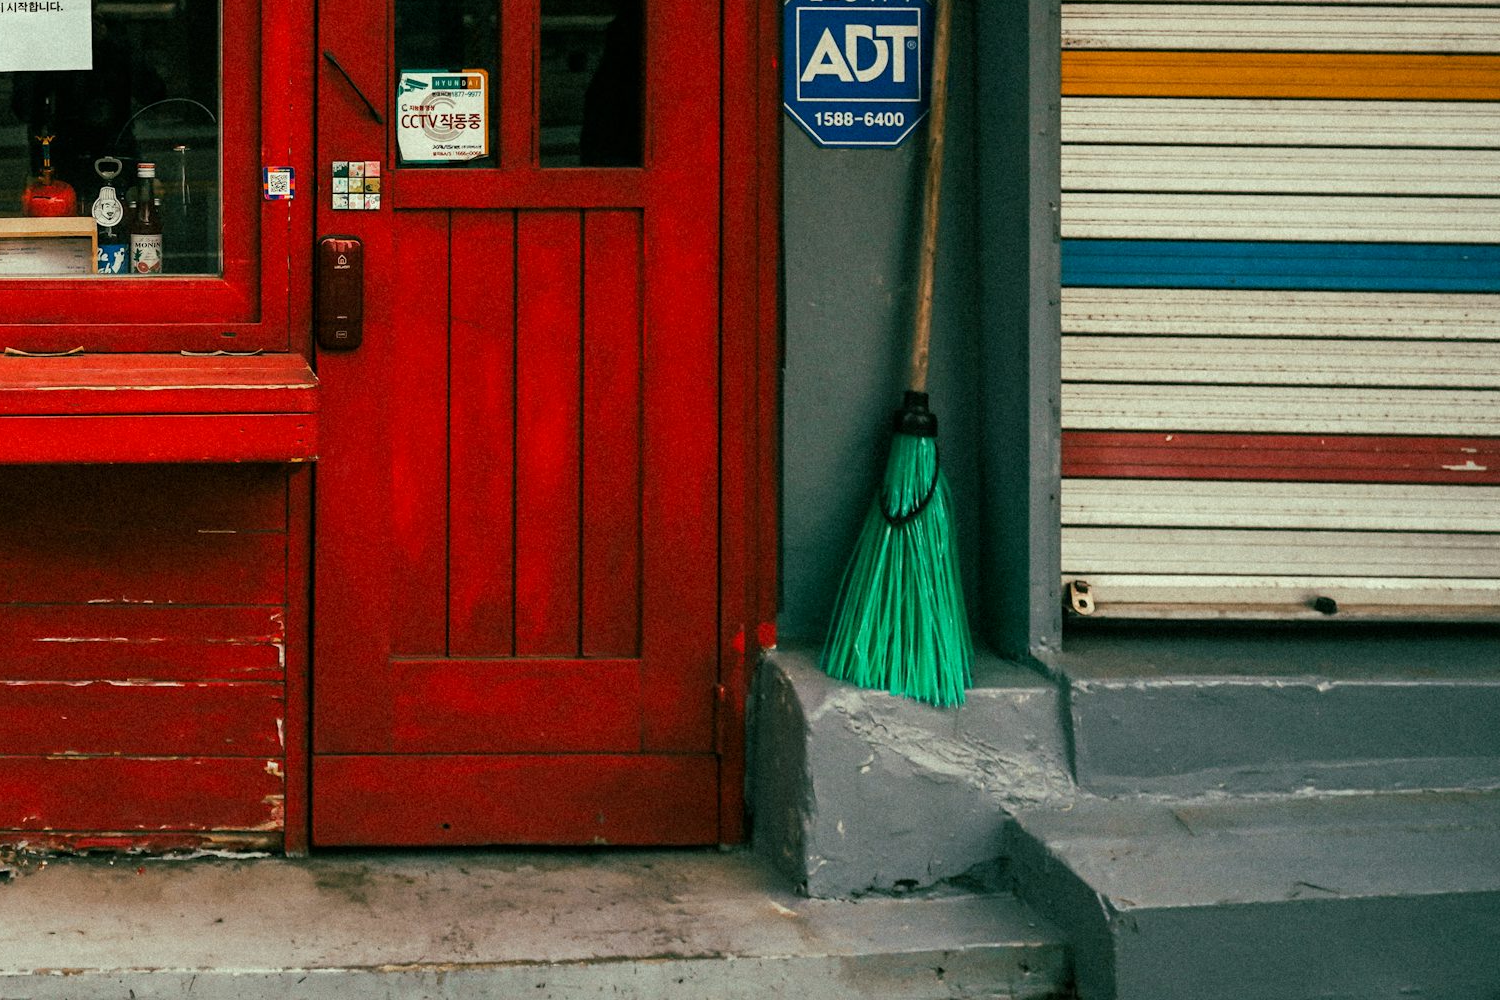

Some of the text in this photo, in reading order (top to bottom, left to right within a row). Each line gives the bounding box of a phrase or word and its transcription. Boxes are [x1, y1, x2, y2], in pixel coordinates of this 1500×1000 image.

[7, 1, 64, 13] 시작합니다.
[800, 24, 918, 83] ADT
[401, 113, 481, 129] CCTV 작동중
[815, 112, 904, 126] 1588-6400
